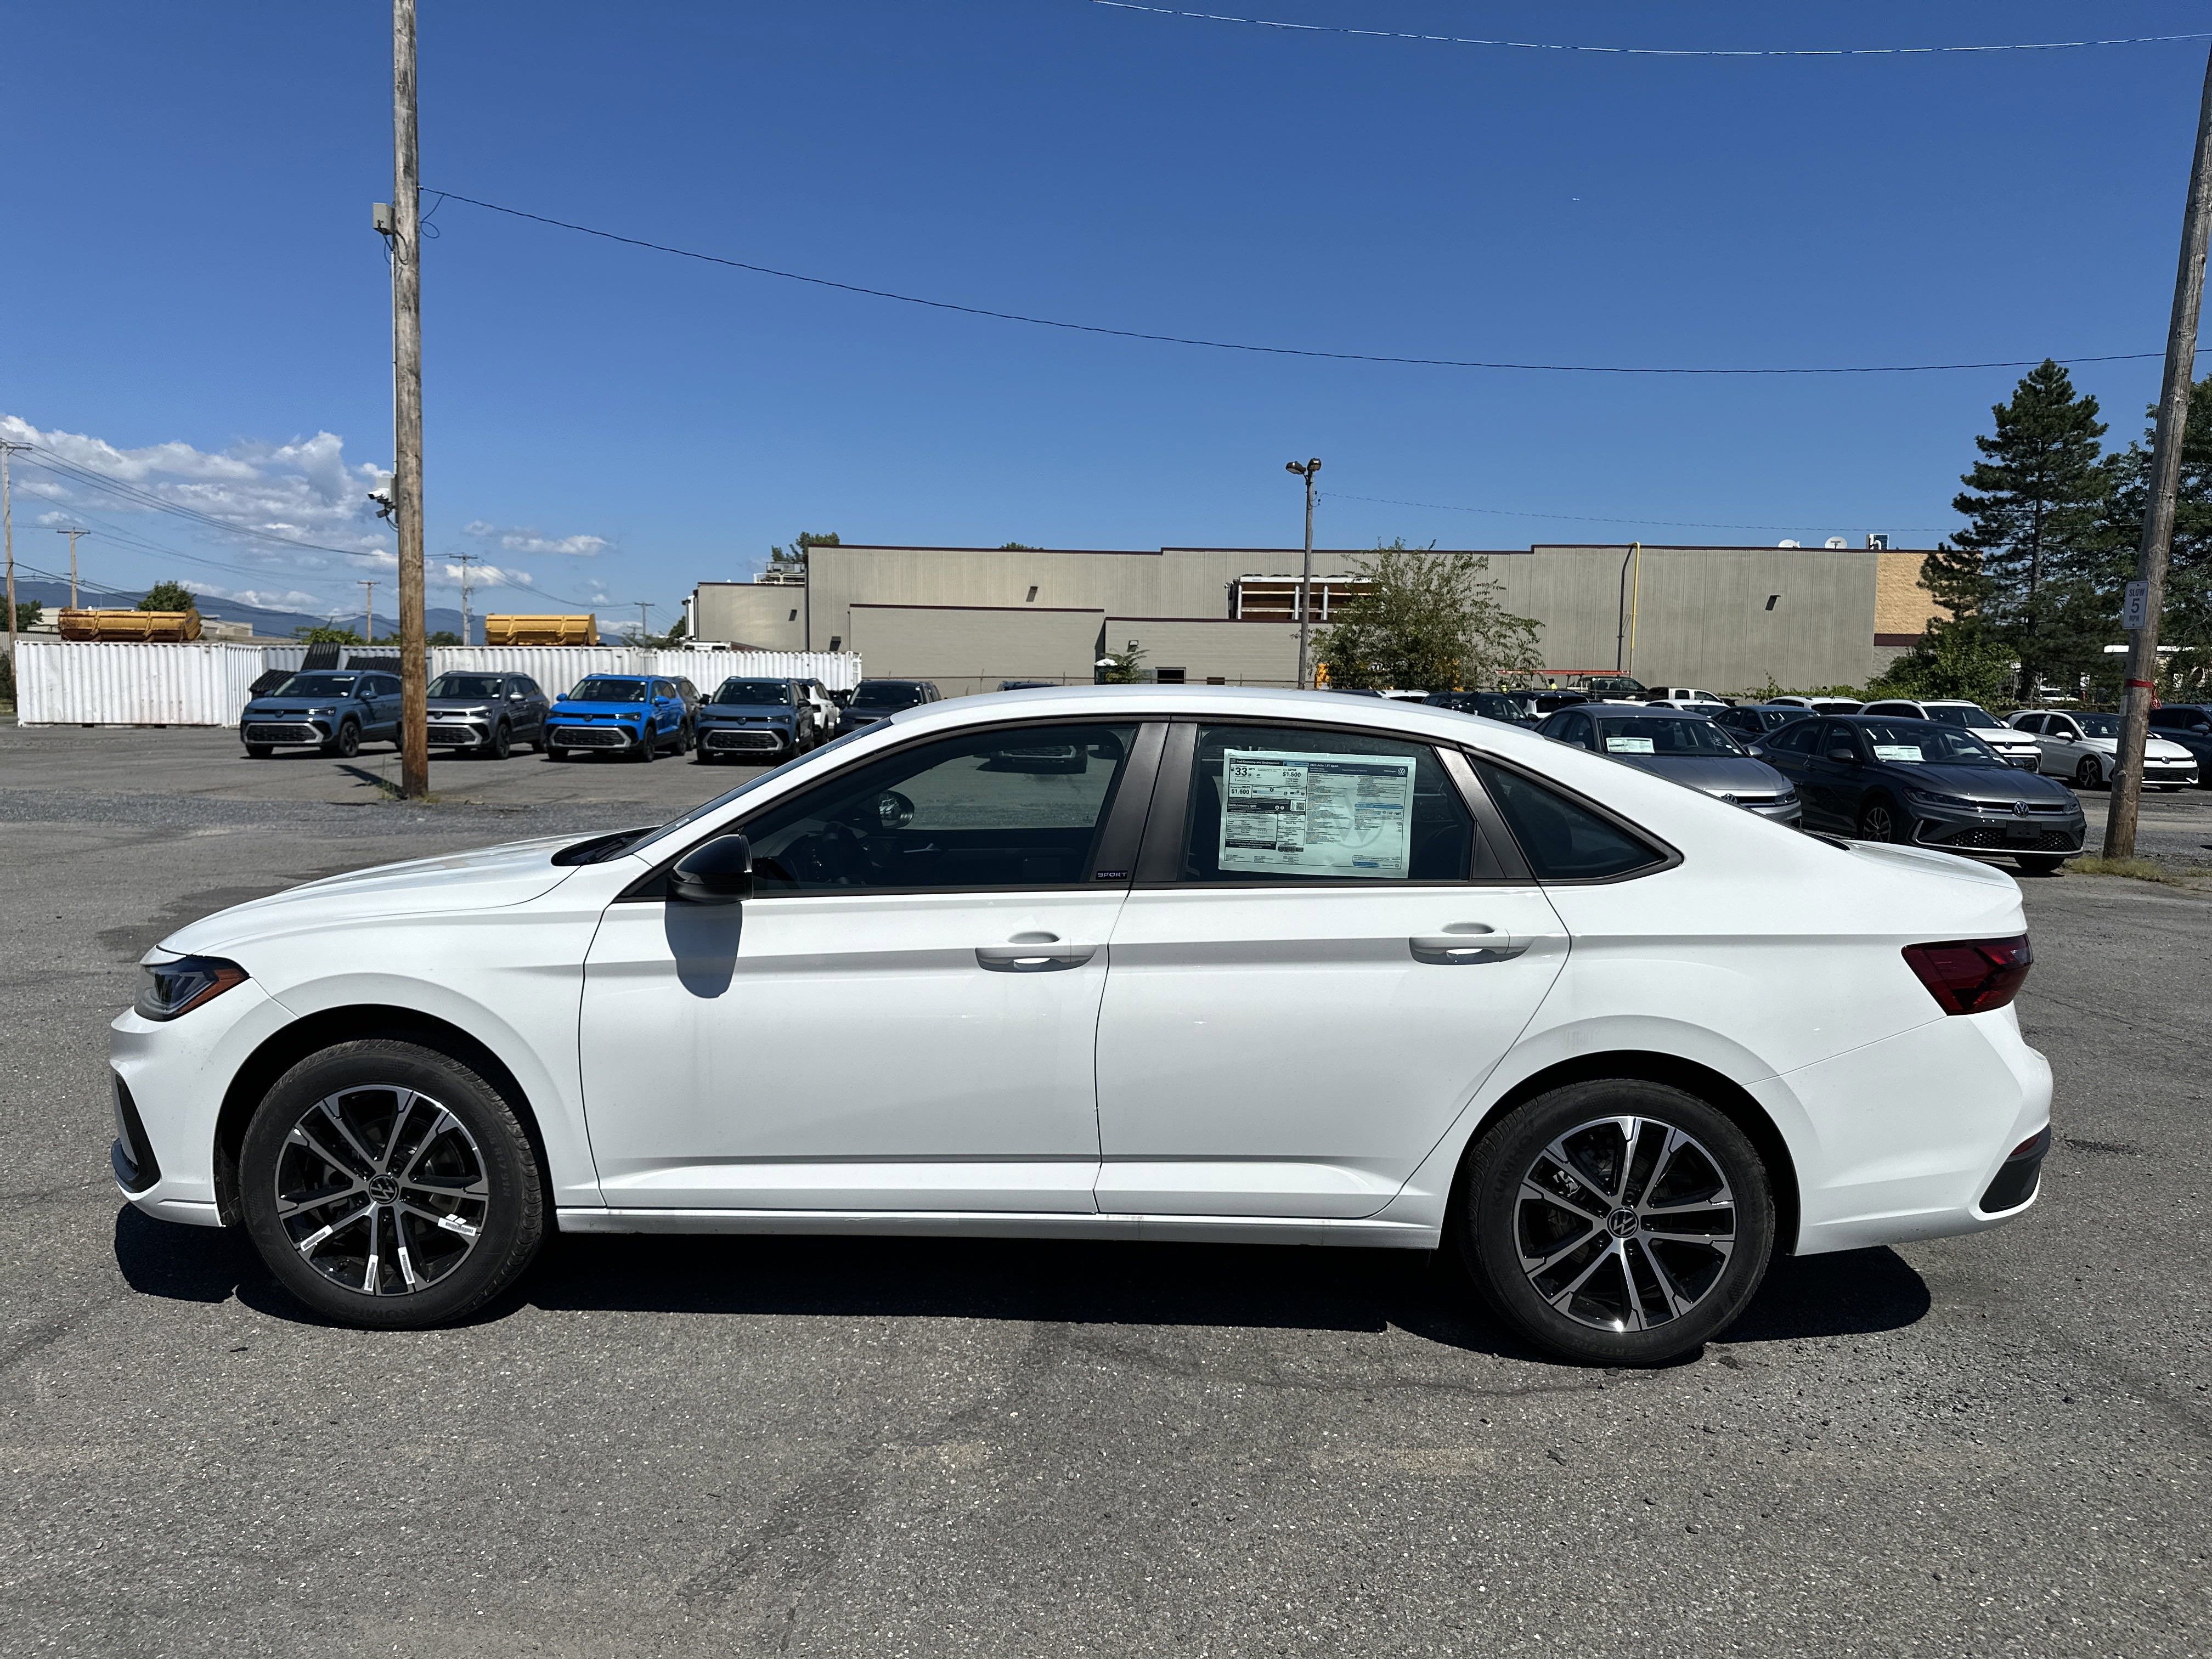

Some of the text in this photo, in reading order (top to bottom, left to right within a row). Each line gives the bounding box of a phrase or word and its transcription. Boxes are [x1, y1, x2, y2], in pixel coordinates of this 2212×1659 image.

[2129, 588, 2145, 596] SLOW
[2131, 598, 2140, 613] 5
[1235, 767, 1248, 776] 33
